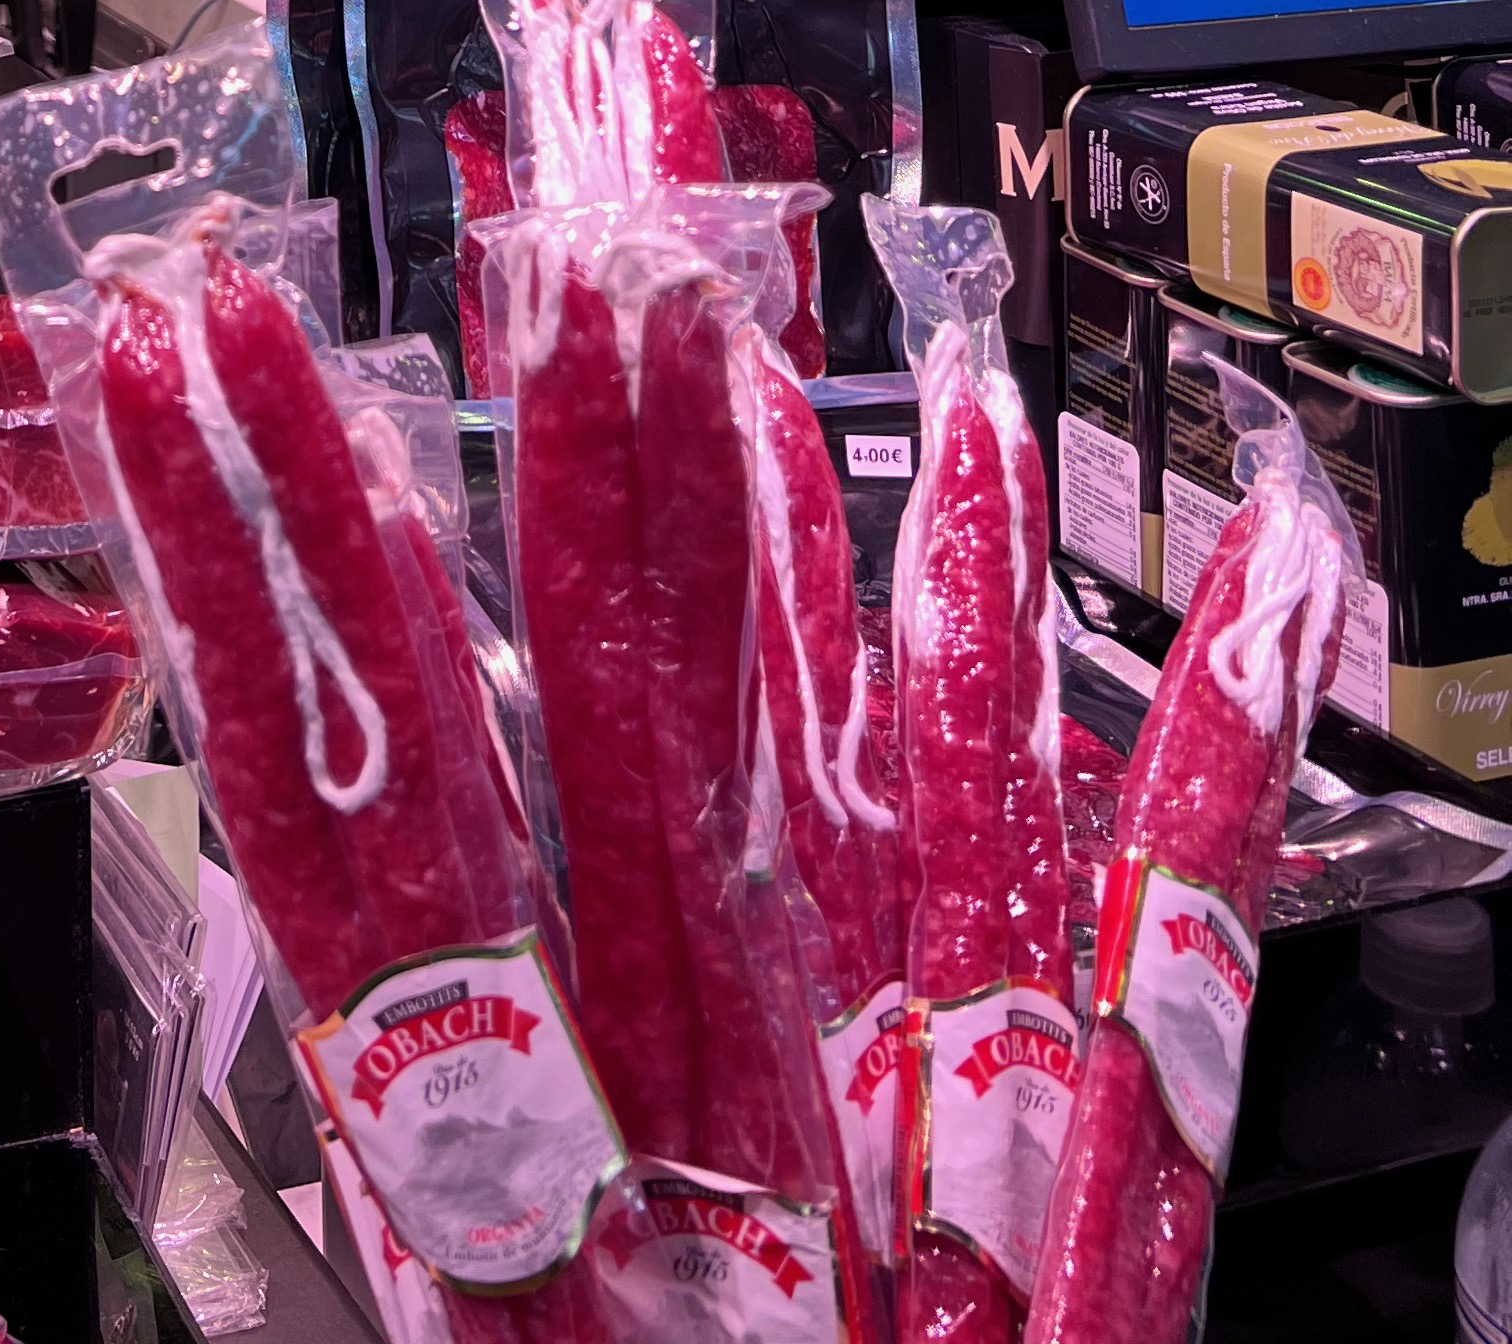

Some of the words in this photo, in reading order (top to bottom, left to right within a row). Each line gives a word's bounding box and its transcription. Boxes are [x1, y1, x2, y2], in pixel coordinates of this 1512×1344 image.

[995, 120, 1066, 202] M
[1221, 162, 1233, 219] Producto
[1221, 220, 1232, 235] de
[1188, 919, 1248, 1003] OBAC
[383, 985, 461, 1025] EMBOTITS
[1012, 1011, 1067, 1045] EMBOTITS
[366, 1000, 495, 1080] OBACH
